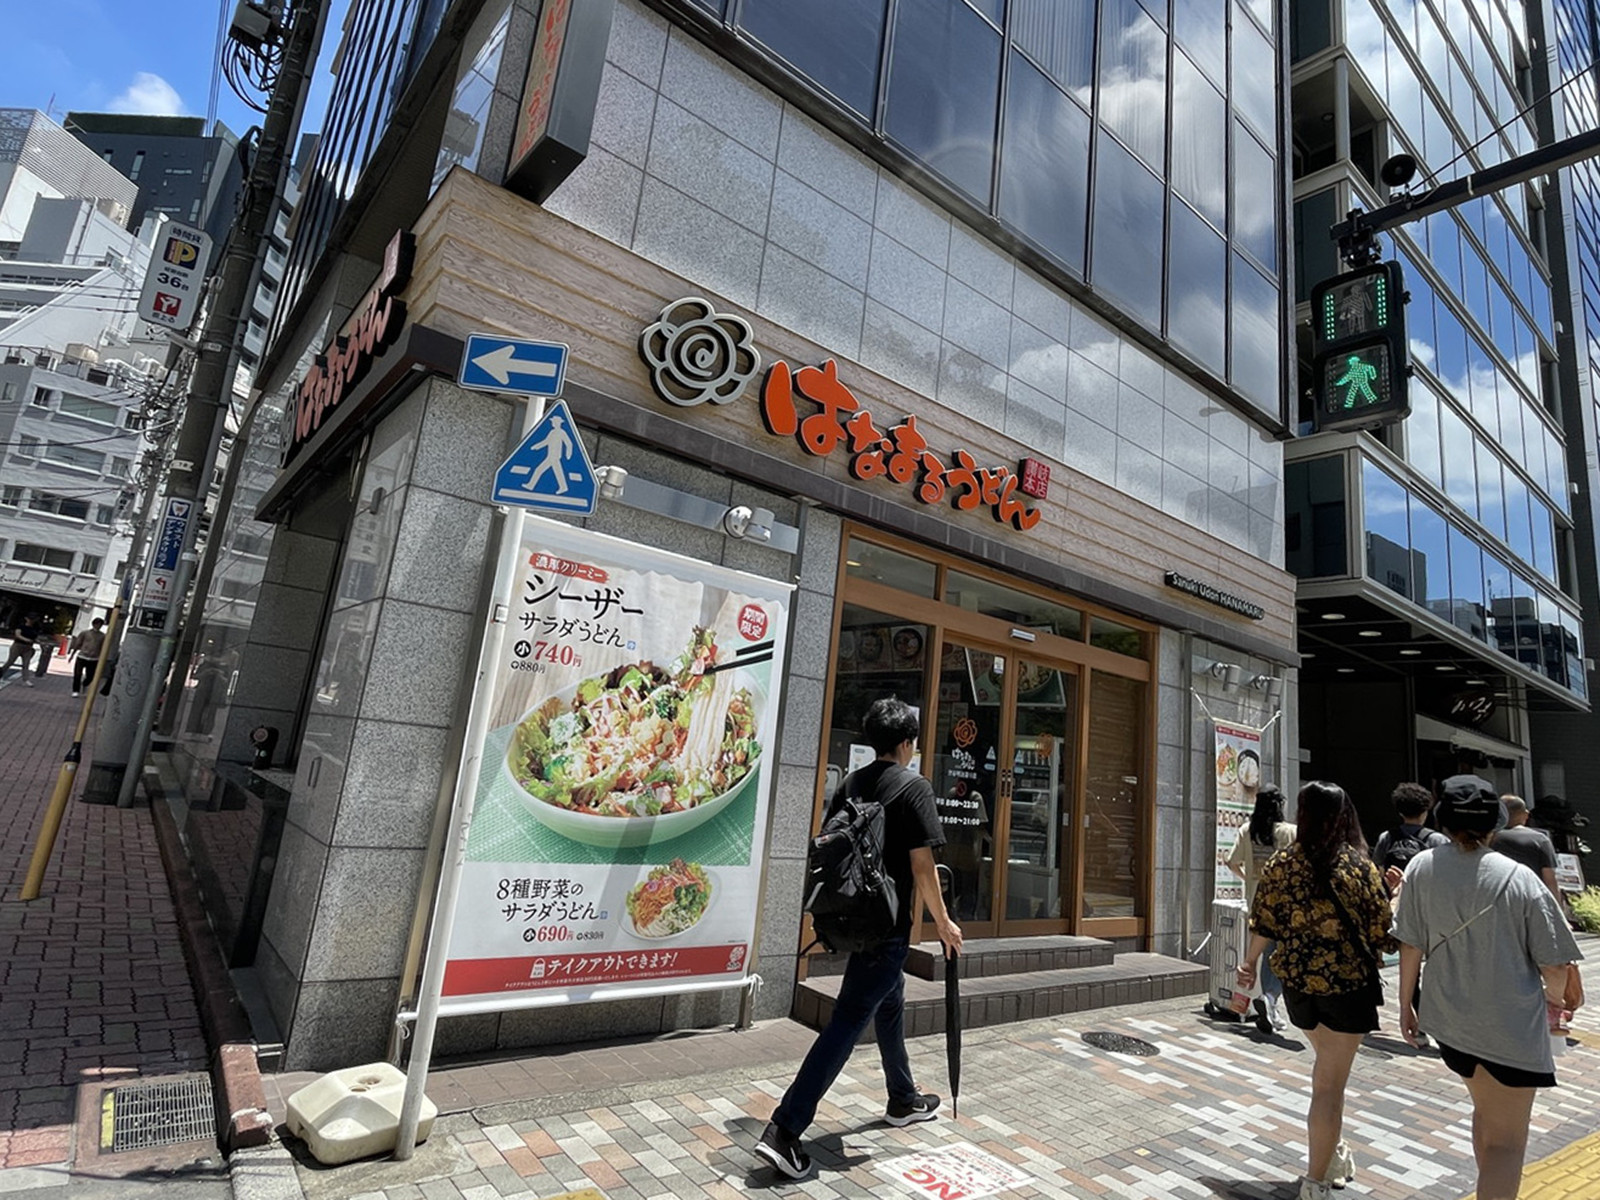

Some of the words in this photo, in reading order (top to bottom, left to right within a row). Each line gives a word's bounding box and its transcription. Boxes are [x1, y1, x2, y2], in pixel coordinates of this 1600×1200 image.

[761, 358, 1041, 531] はなまるうどん
[536, 555, 603, 579] 濃厚クリーミー
[524, 574, 644, 620] シーザー
[1173, 574, 1198, 592] Sanuki
[1200, 583, 1220, 601] Udon
[1221, 591, 1263, 618] HANAMARU
[743, 606, 766, 626] 期間
[519, 612, 626, 648] サラダうどん
[741, 619, 763, 639] 限定
[534, 640, 582, 667] 740円
[496, 878, 584, 900] 8種野菜の
[501, 901, 599, 922] サラダうどん
[537, 925, 573, 942] 690円
[546, 951, 679, 977] テイクアウトできます!
